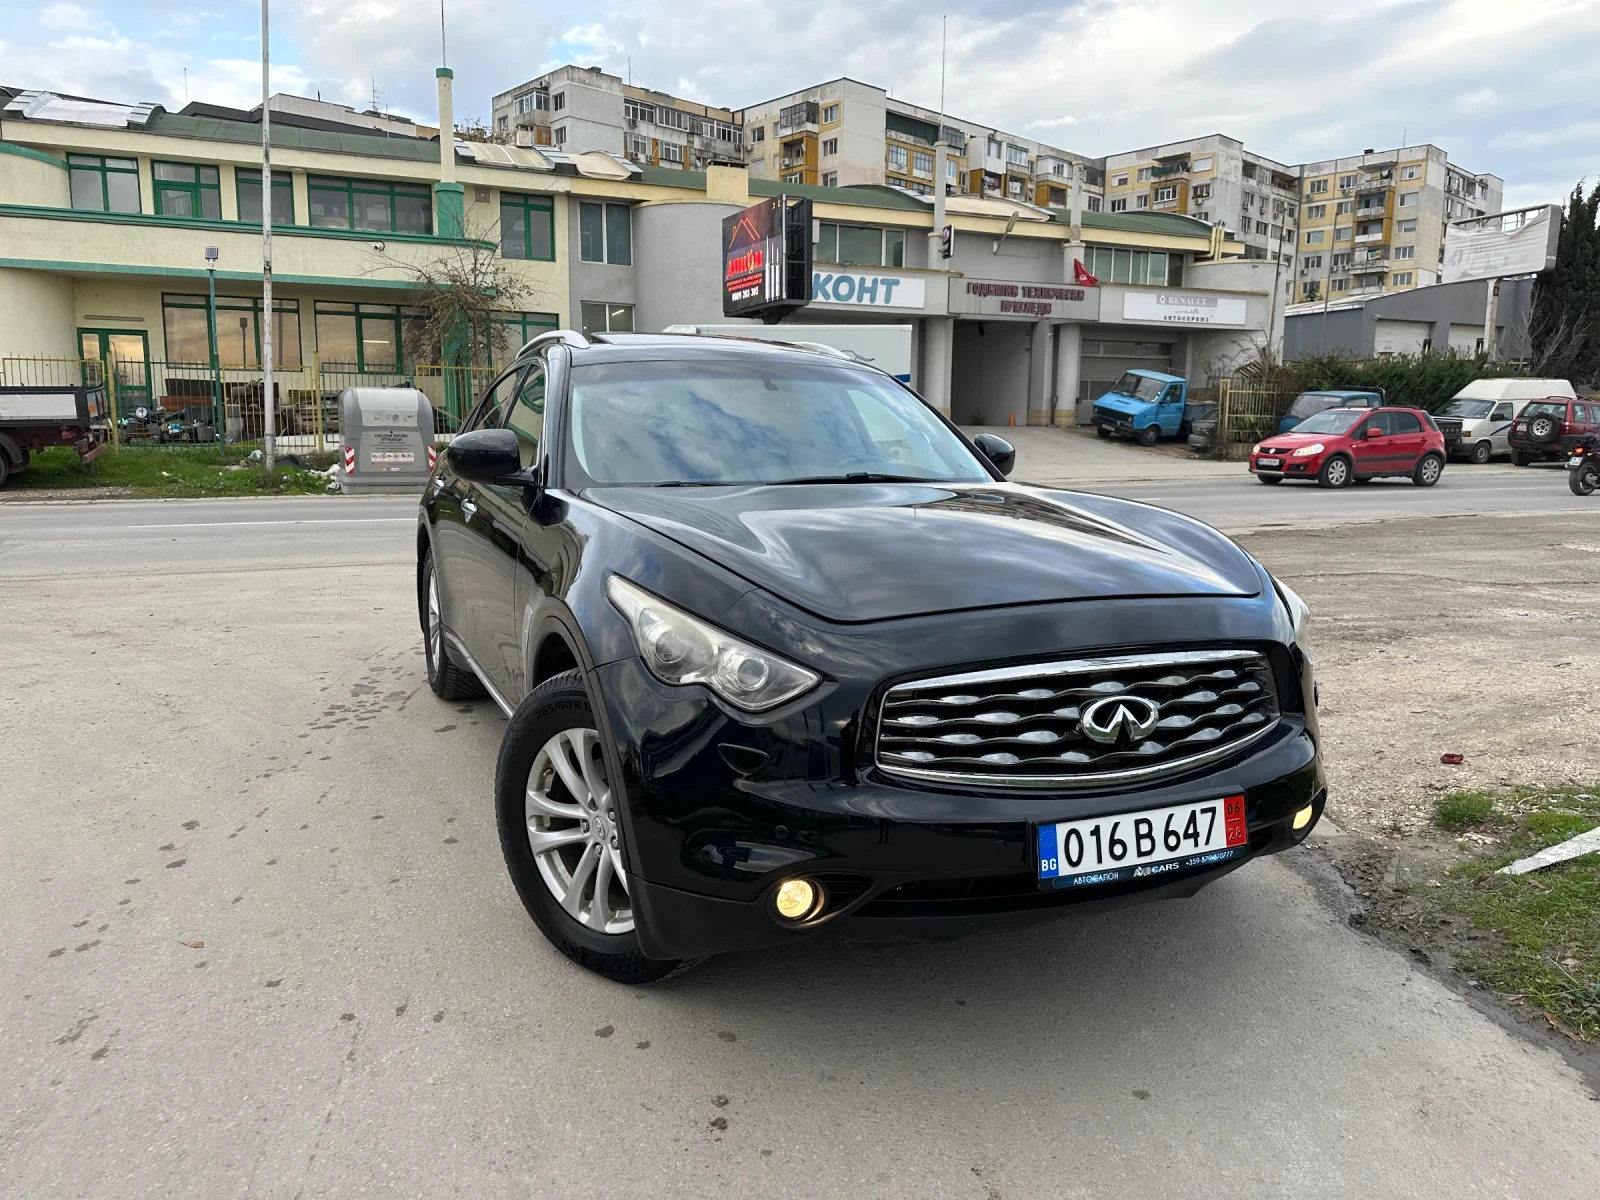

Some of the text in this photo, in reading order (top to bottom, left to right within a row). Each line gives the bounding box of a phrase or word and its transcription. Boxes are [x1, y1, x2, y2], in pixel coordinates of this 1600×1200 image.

[812, 273, 900, 304] КОНТ
[967, 282, 1085, 301] ГОДИШНИ ТЕХНИЧЕСКИ
[1001, 300, 1052, 315] ПРЕГЛЕДИ
[1168, 296, 1207, 307] RENAULT
[535, 700, 573, 720] 265/60
[574, 701, 582, 710] R
[1227, 802, 1240, 815] 06
[1228, 827, 1242, 841] 28
[1041, 858, 1057, 872] BG
